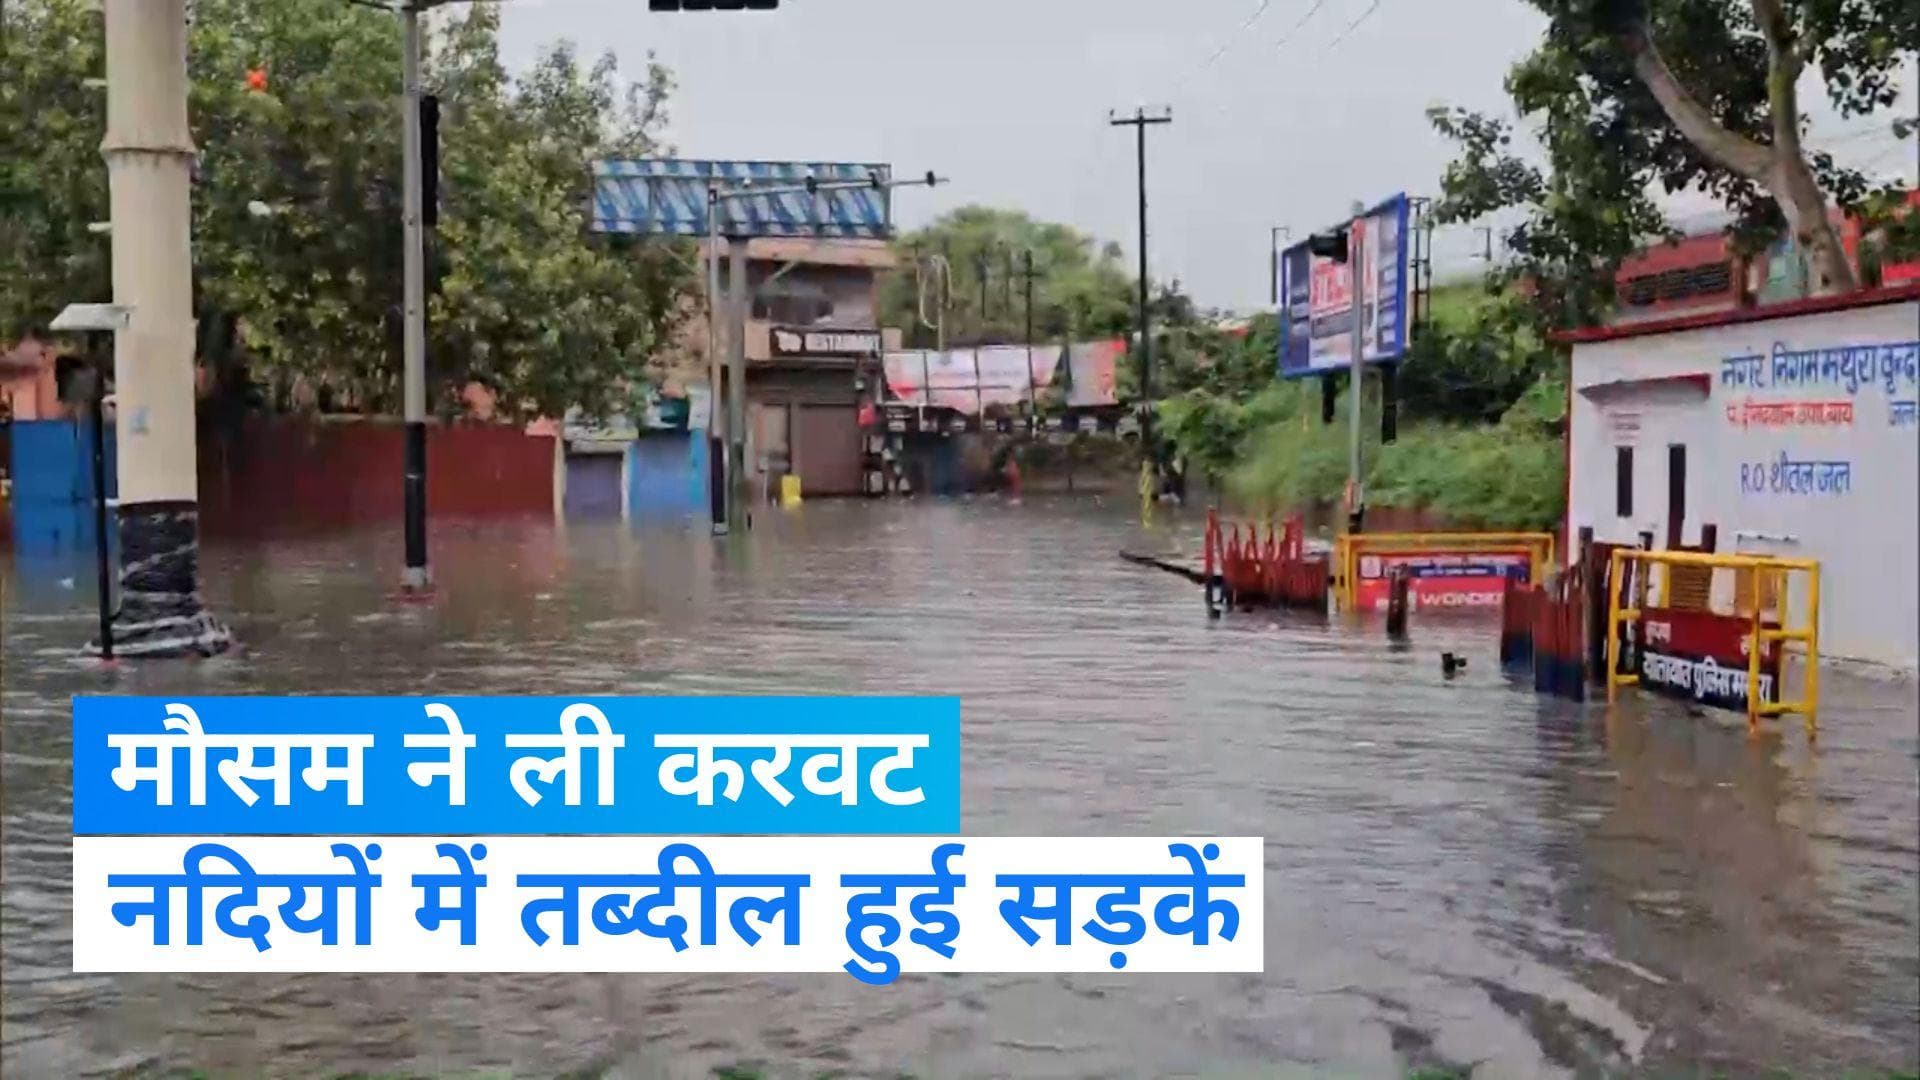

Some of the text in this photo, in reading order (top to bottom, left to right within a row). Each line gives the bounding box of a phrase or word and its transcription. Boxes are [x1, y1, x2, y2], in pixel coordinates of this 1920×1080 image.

[1773, 341, 1819, 387] निगम
[1820, 345, 1877, 394] मथुरा
[1770, 450, 1815, 495] शीतल
[1818, 461, 1850, 493] जल
[1693, 655, 1730, 698] पुलिस
